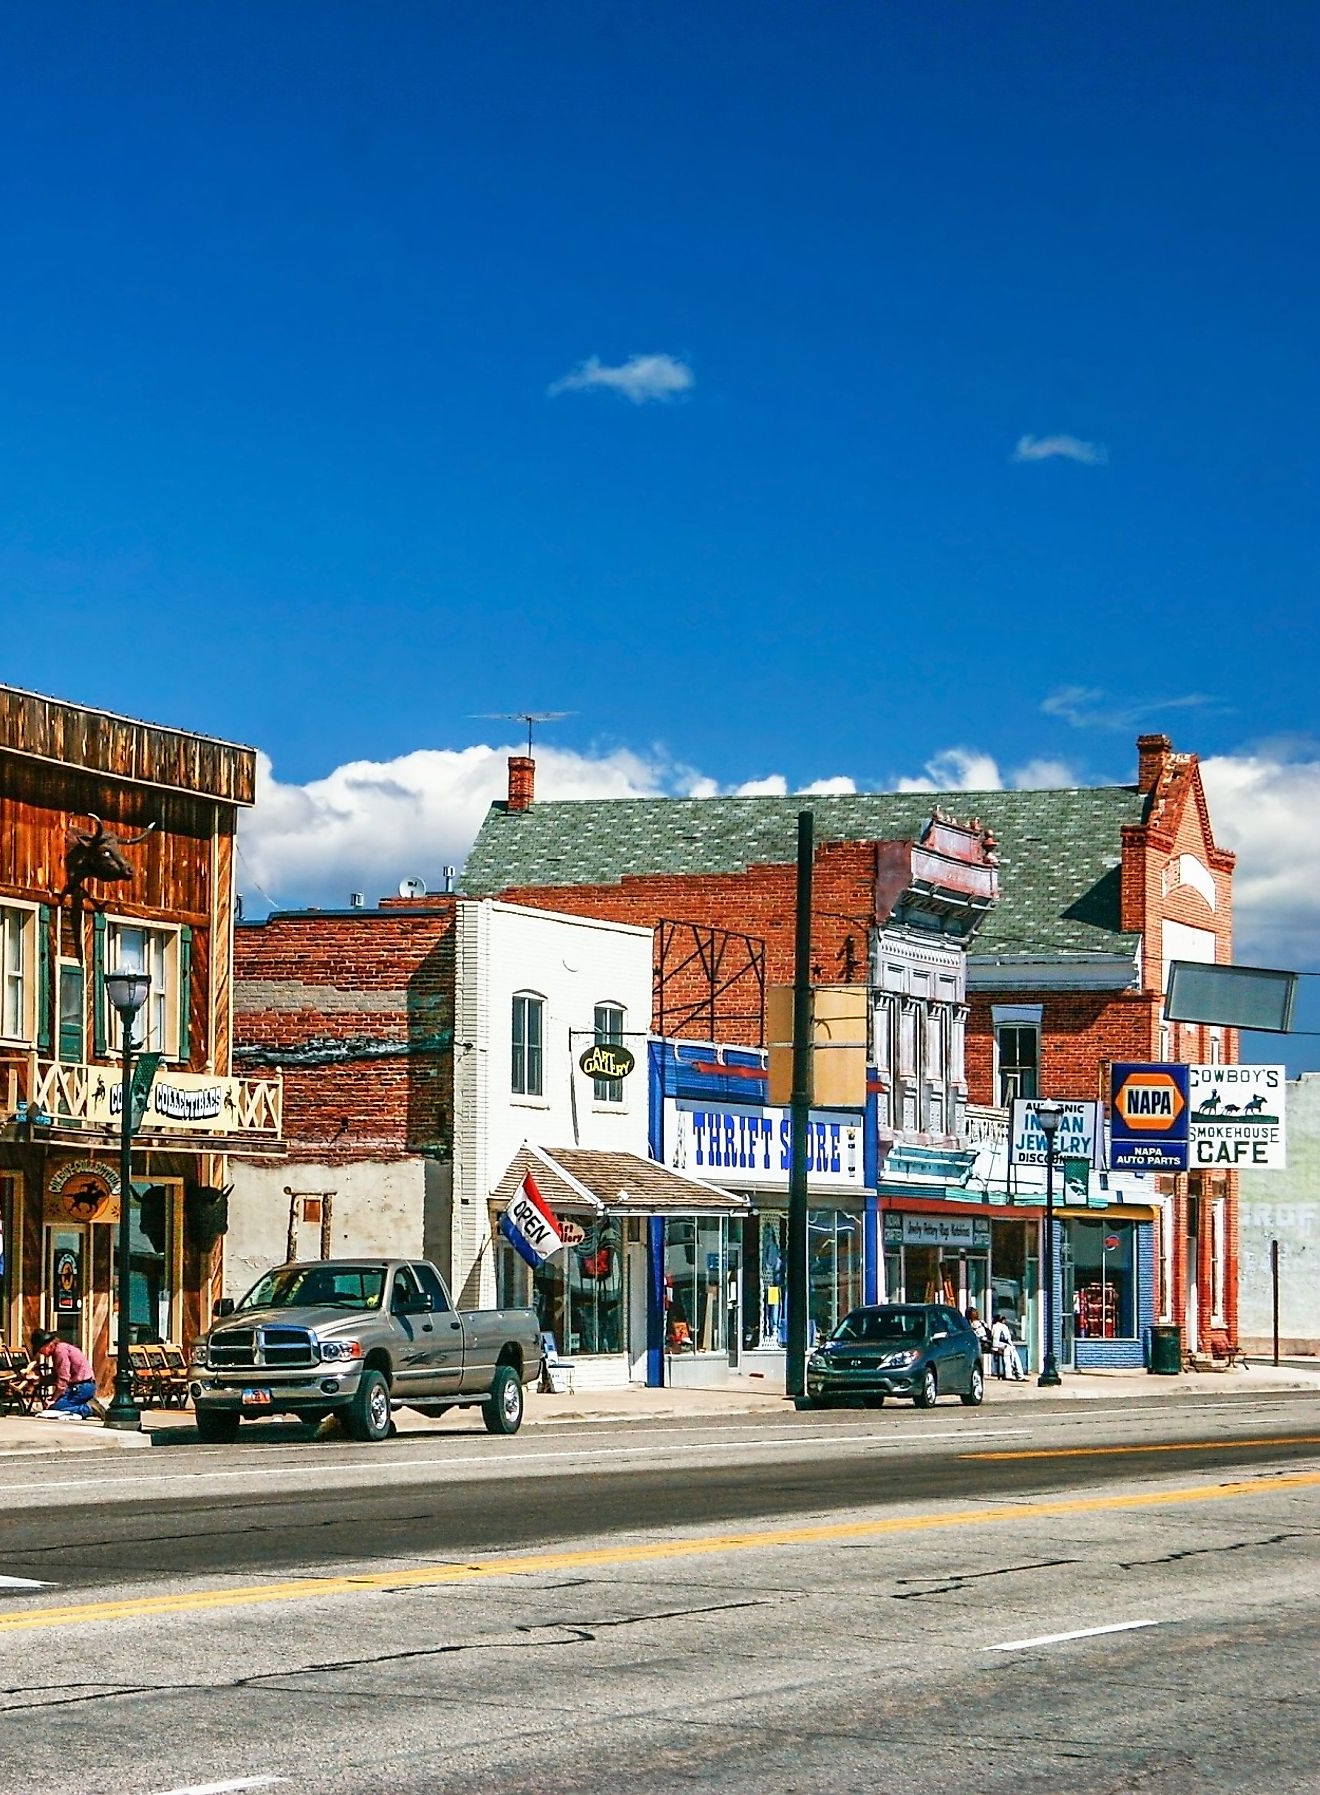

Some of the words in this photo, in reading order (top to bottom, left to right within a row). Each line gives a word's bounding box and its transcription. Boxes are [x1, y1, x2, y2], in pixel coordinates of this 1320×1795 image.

[593, 1047, 616, 1064] ART
[584, 1058, 630, 1077] GALLERY
[155, 1082, 222, 1121] COLLECTIBLES
[1127, 1089, 1172, 1115] NAPA
[1025, 1114, 1084, 1133] INAN
[693, 1112, 773, 1169] THRIFT
[780, 1119, 841, 1172] SORE
[1134, 1147, 1162, 1156] NAPA
[1197, 1141, 1269, 1164] CAFE
[1117, 1156, 1144, 1165] AUTO
[1147, 1156, 1181, 1165] PARTS
[513, 1200, 551, 1244] OPEN
